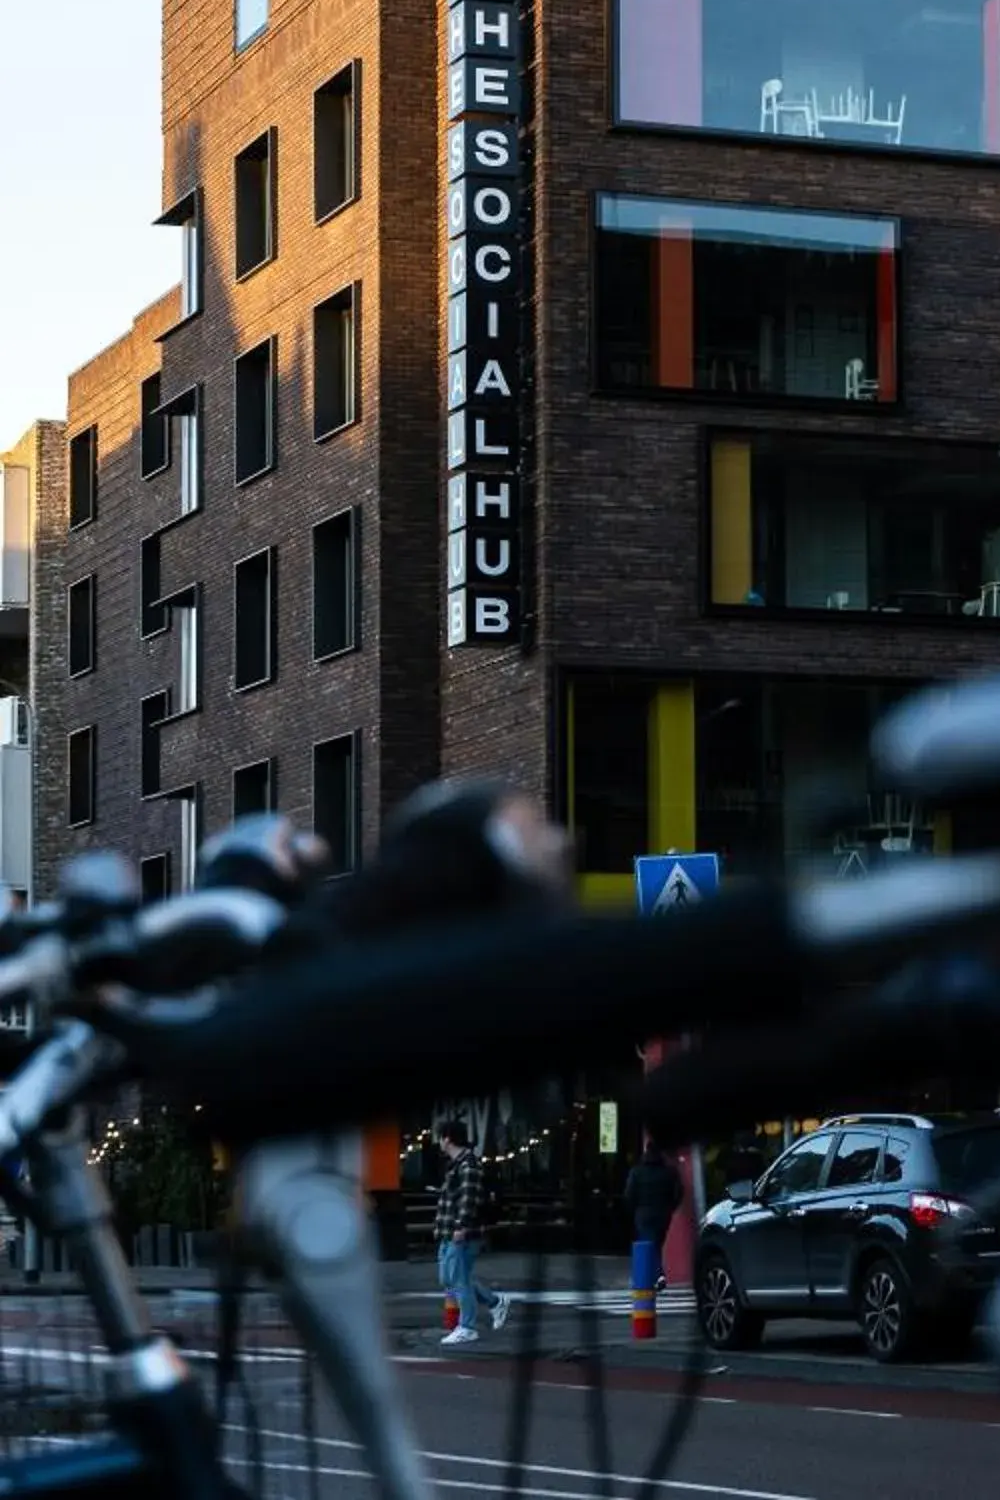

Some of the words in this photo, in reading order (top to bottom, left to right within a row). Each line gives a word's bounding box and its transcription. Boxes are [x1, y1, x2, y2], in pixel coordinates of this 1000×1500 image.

[449, 127, 464, 459] SOCIAL
[474, 129, 511, 455] SOCIAL
[451, 483, 464, 635] HUB
[475, 481, 510, 633] HUB
